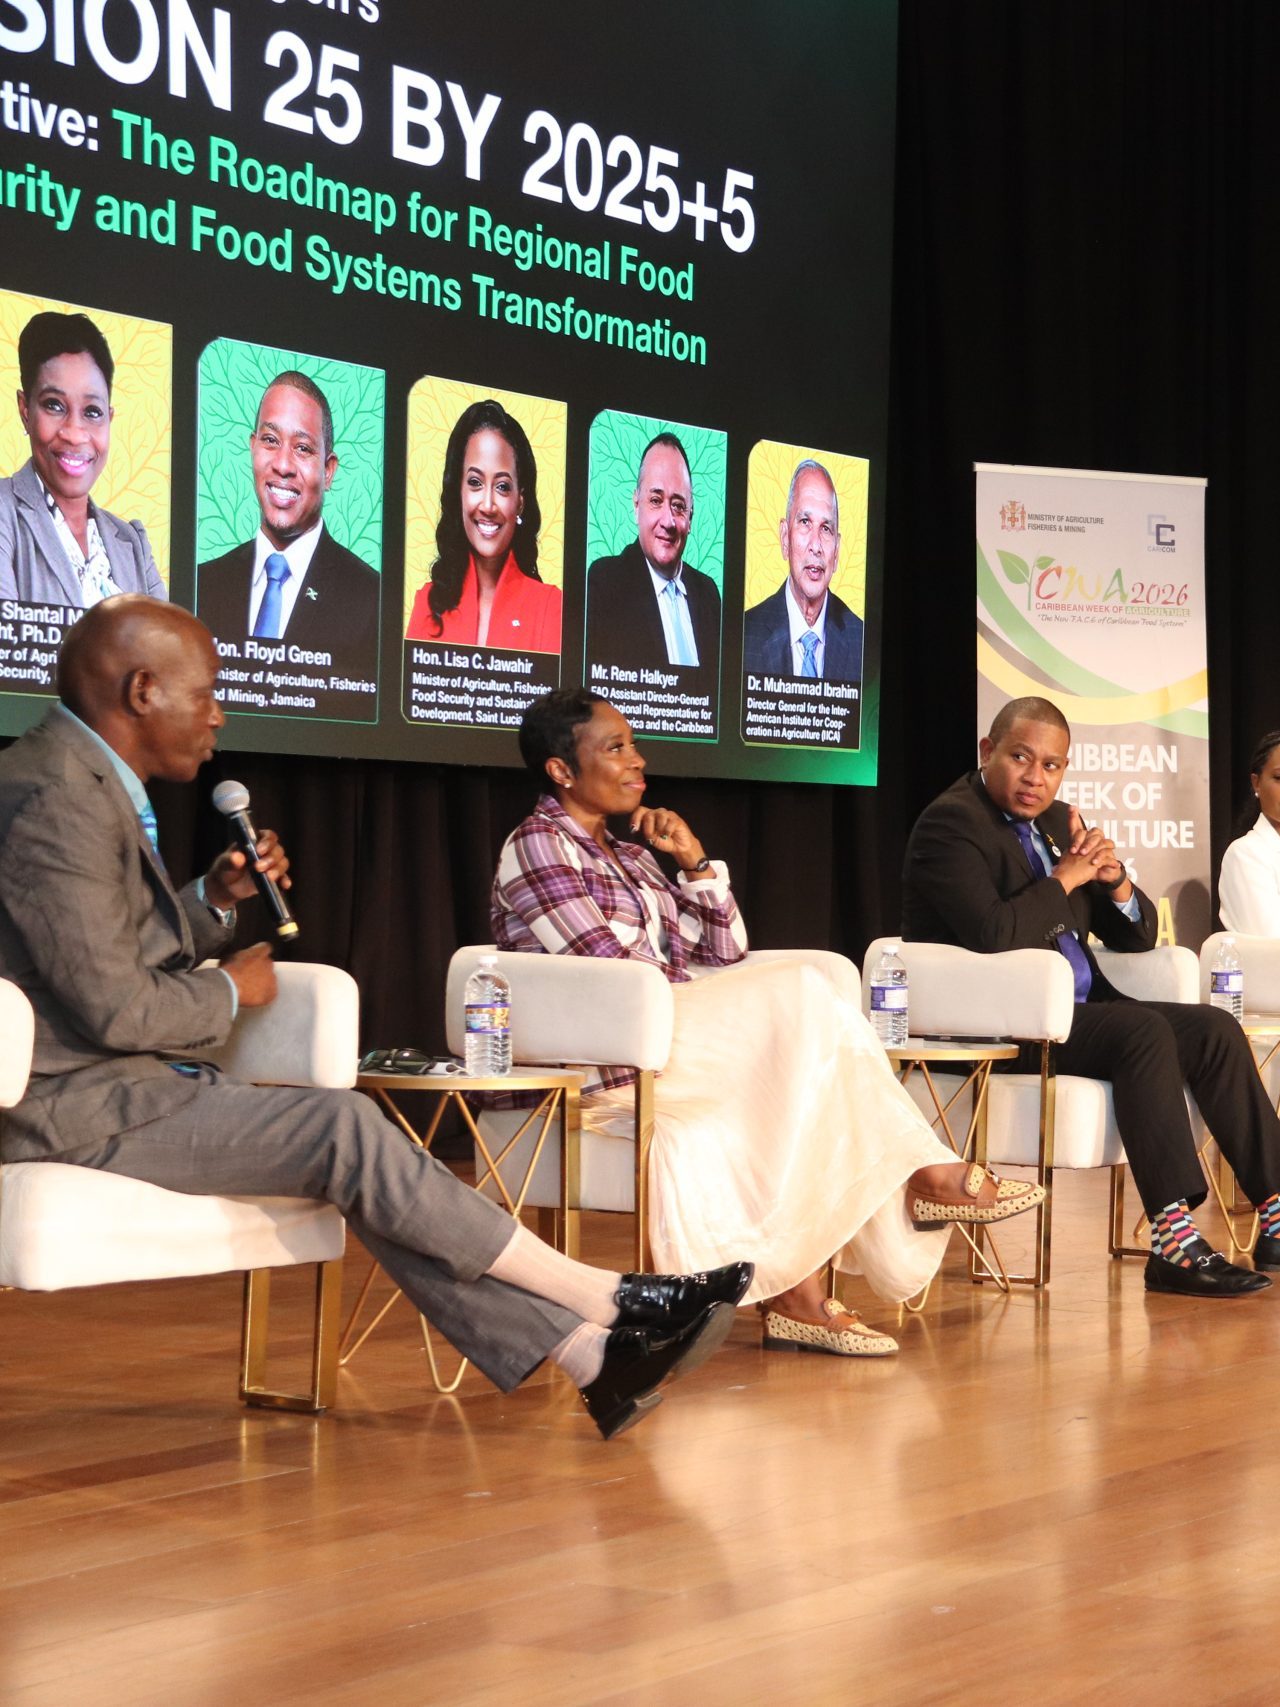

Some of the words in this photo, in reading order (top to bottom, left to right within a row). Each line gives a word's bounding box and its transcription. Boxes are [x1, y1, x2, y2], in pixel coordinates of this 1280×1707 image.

[0, 0, 231, 111] ION
[264, 30, 363, 145] 25
[392, 65, 502, 181] BY
[522, 110, 755, 253] 2025+5
[0, 80, 98, 151] tive:
[112, 109, 195, 175] The
[209, 136, 396, 234] Roadmap
[408, 192, 458, 242] for
[468, 206, 609, 280] Regional
[620, 245, 693, 301] Food
[0, 163, 81, 231] rity
[95, 200, 176, 245] and
[191, 205, 292, 272] Food
[305, 235, 461, 311] Systems
[472, 273, 707, 364] Transformation
[1028, 513, 1056, 522] MINISTRY
[1065, 516, 1104, 525] AGRICULTURE
[1028, 523, 1057, 532] FISHERIES
[1064, 525, 1086, 533] MINING
[1130, 582, 1188, 606] 2026
[2, 601, 64, 624] Shantal
[1035, 602, 1084, 612] CARIBBEAN
[1085, 604, 1110, 613] WEEK
[1112, 605, 1124, 613] OF
[13, 647, 28, 662] of
[213, 637, 241, 657] on.
[245, 640, 285, 664] Floyd
[288, 645, 331, 666] Green
[413, 648, 441, 665] Hon.
[444, 651, 469, 668] Lisa
[472, 653, 485, 670] C.
[487, 655, 533, 674] Jawahir
[253, 671, 264, 683] of
[266, 671, 327, 690] Agriculture,
[330, 677, 376, 693] Fisheries
[412, 672, 449, 686] Minister
[451, 677, 462, 688] of
[462, 677, 512, 694] Agriculture,
[591, 664, 608, 680] Mr.
[610, 666, 637, 682] Rene
[640, 668, 678, 689] Halkyer
[610, 688, 646, 701] Assistant
[647, 690, 709, 706] Director-General
[747, 675, 761, 691] Dr.
[764, 677, 822, 696] Muhammad
[824, 682, 859, 699] Ibrahim
[228, 688, 268, 707] Mining,
[271, 692, 315, 708] Jamaica
[412, 689, 436, 702] Food
[437, 691, 474, 707] Security
[476, 695, 493, 707] and
[747, 698, 776, 711] Director
[778, 700, 805, 712] General
[807, 702, 817, 714] for
[818, 703, 830, 714] the
[832, 705, 850, 716] Inter-
[412, 706, 473, 724] Development,
[475, 711, 498, 723] Saint
[643, 704, 699, 719] Representative
[701, 709, 712, 720] for
[746, 711, 781, 724] American
[783, 714, 811, 726] Institute
[812, 716, 823, 727] for
[824, 718, 846, 731] Coop-
[646, 720, 660, 730] and
[661, 721, 674, 731] the
[675, 720, 714, 734] Caribbean
[746, 726, 772, 737] eration
[774, 726, 780, 737] in
[781, 727, 820, 740] Agriculture
[1122, 782, 1162, 811] OF
